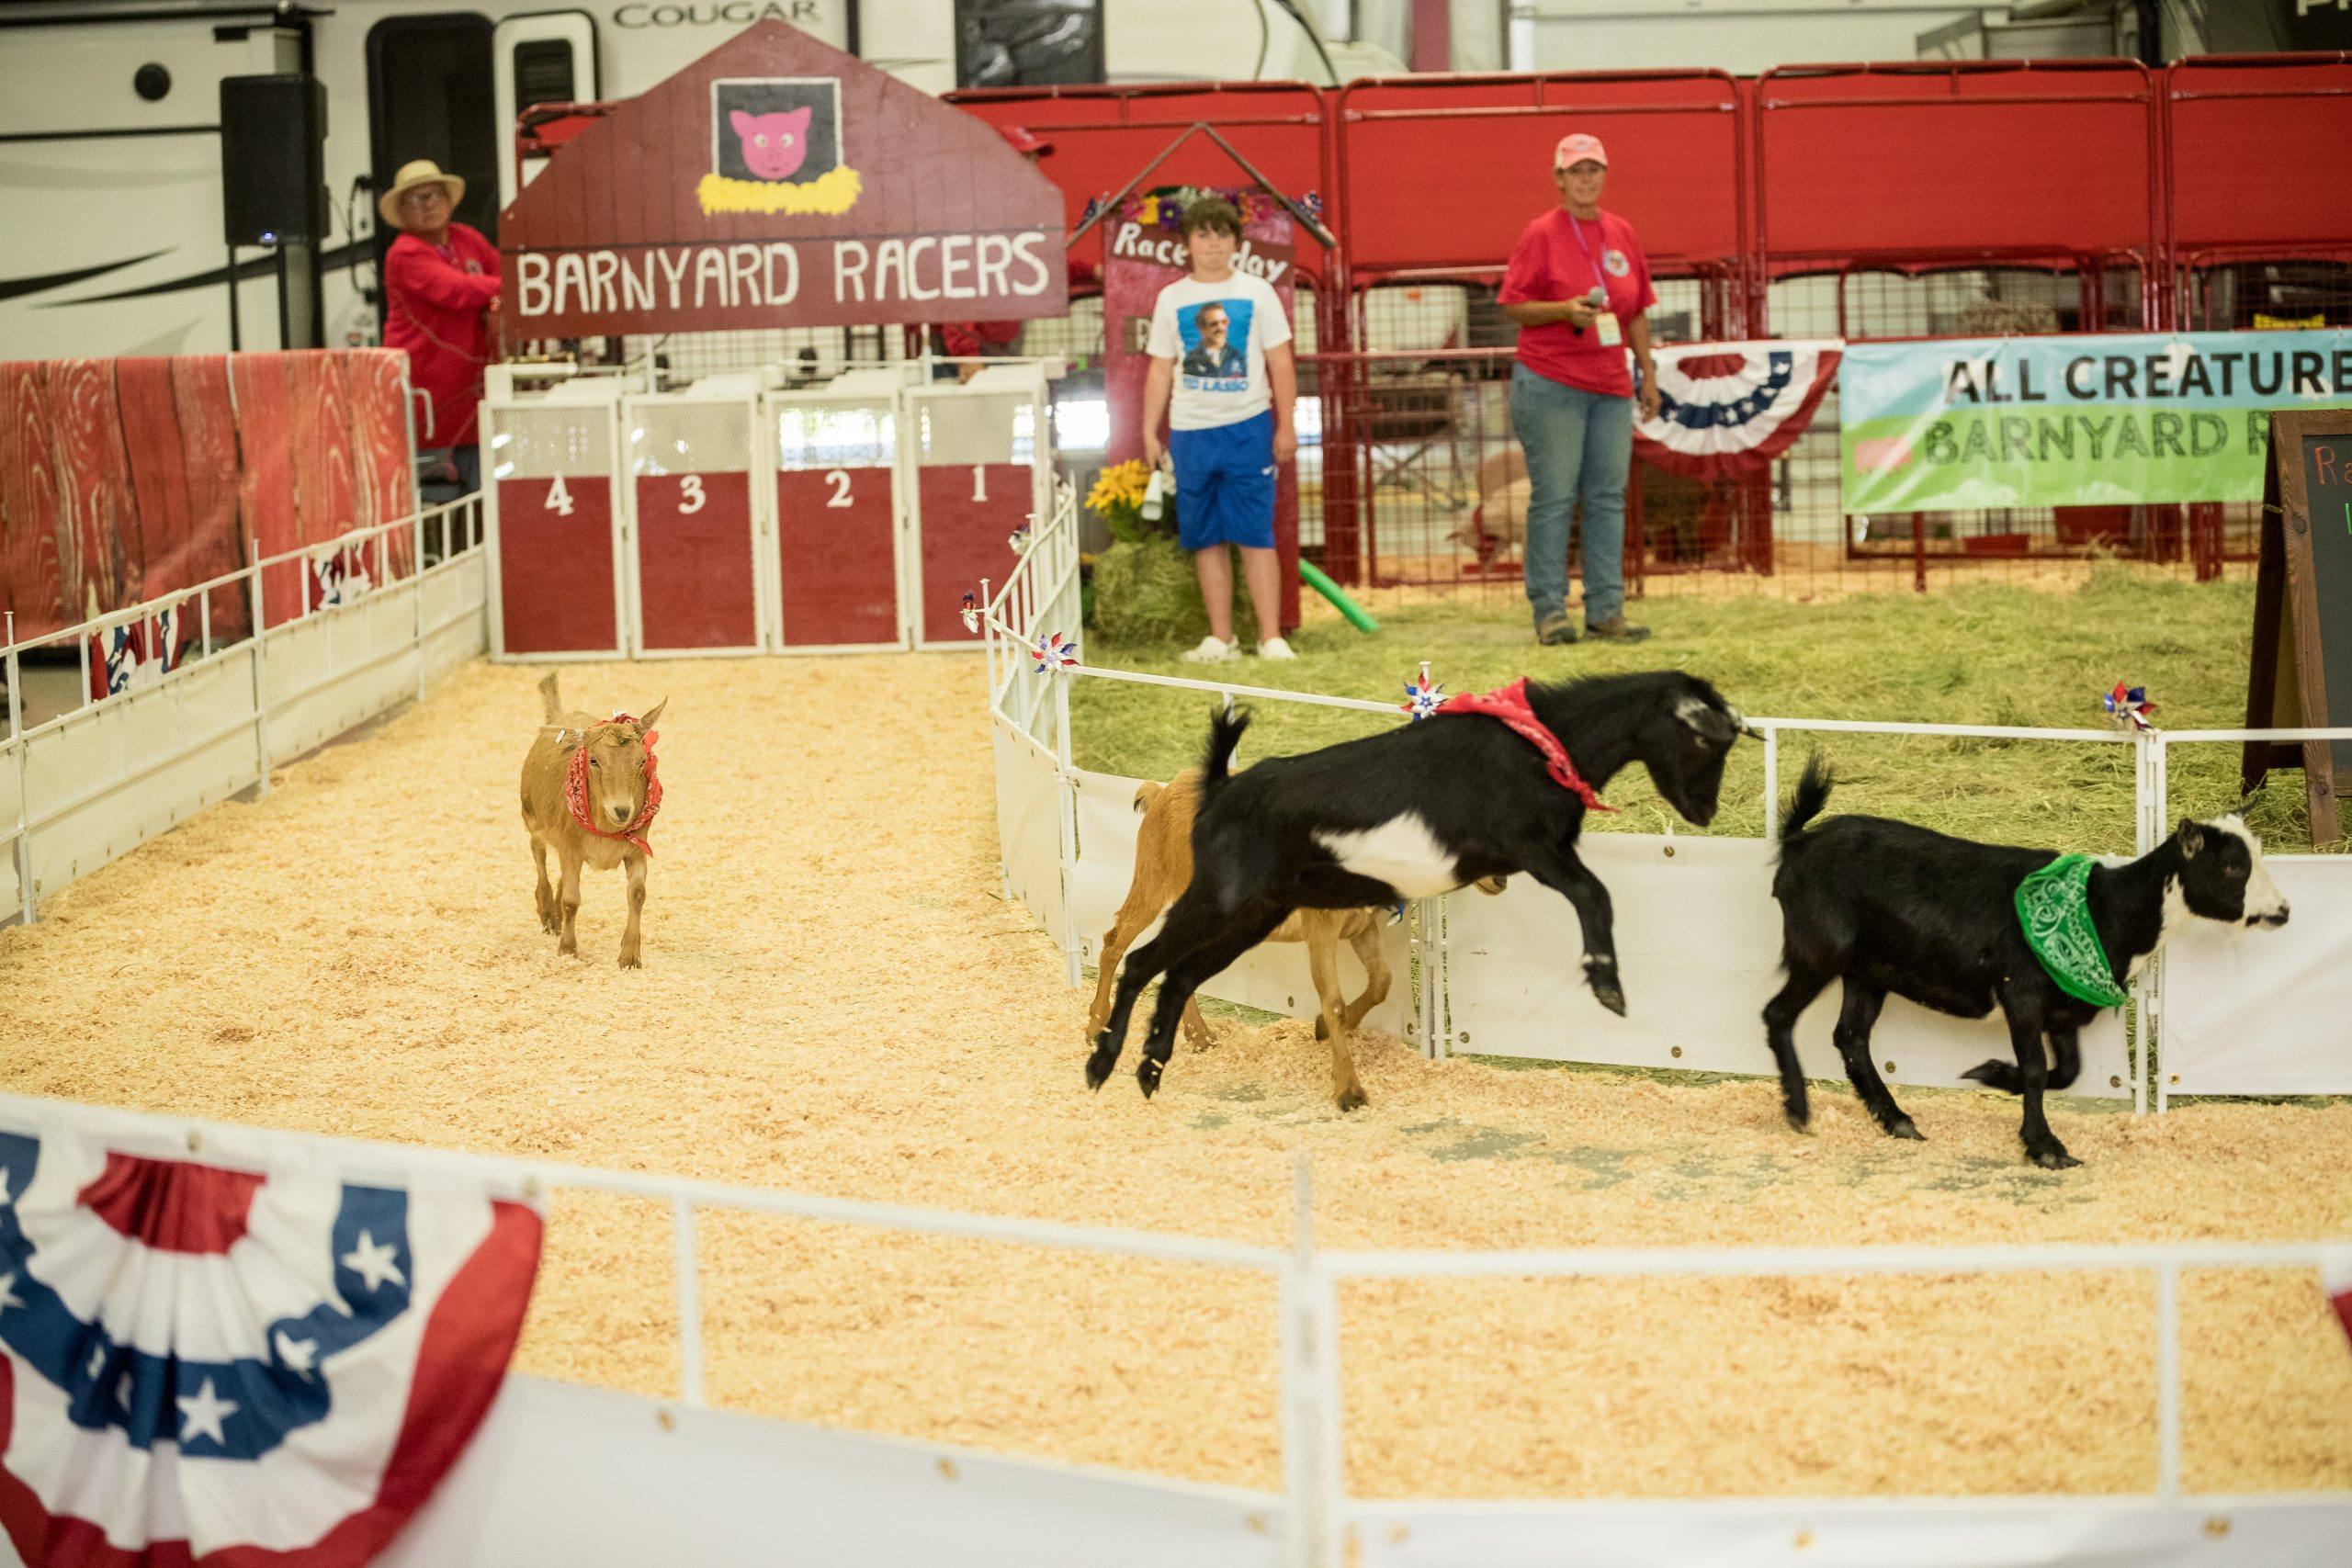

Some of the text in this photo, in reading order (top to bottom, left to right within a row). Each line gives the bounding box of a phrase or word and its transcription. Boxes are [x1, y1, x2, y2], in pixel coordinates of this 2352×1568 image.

[613, 1, 820, 28] COUGAR
[1114, 222, 1287, 282] Race day
[517, 232, 1048, 315] BARNYARD RACERS
[1943, 350, 2352, 404] ALL CREATURE
[1925, 412, 2229, 464] BARNYARD
[545, 473, 574, 515] 4
[678, 475, 706, 513] 3
[827, 470, 854, 506] 2
[972, 467, 988, 501] 1
